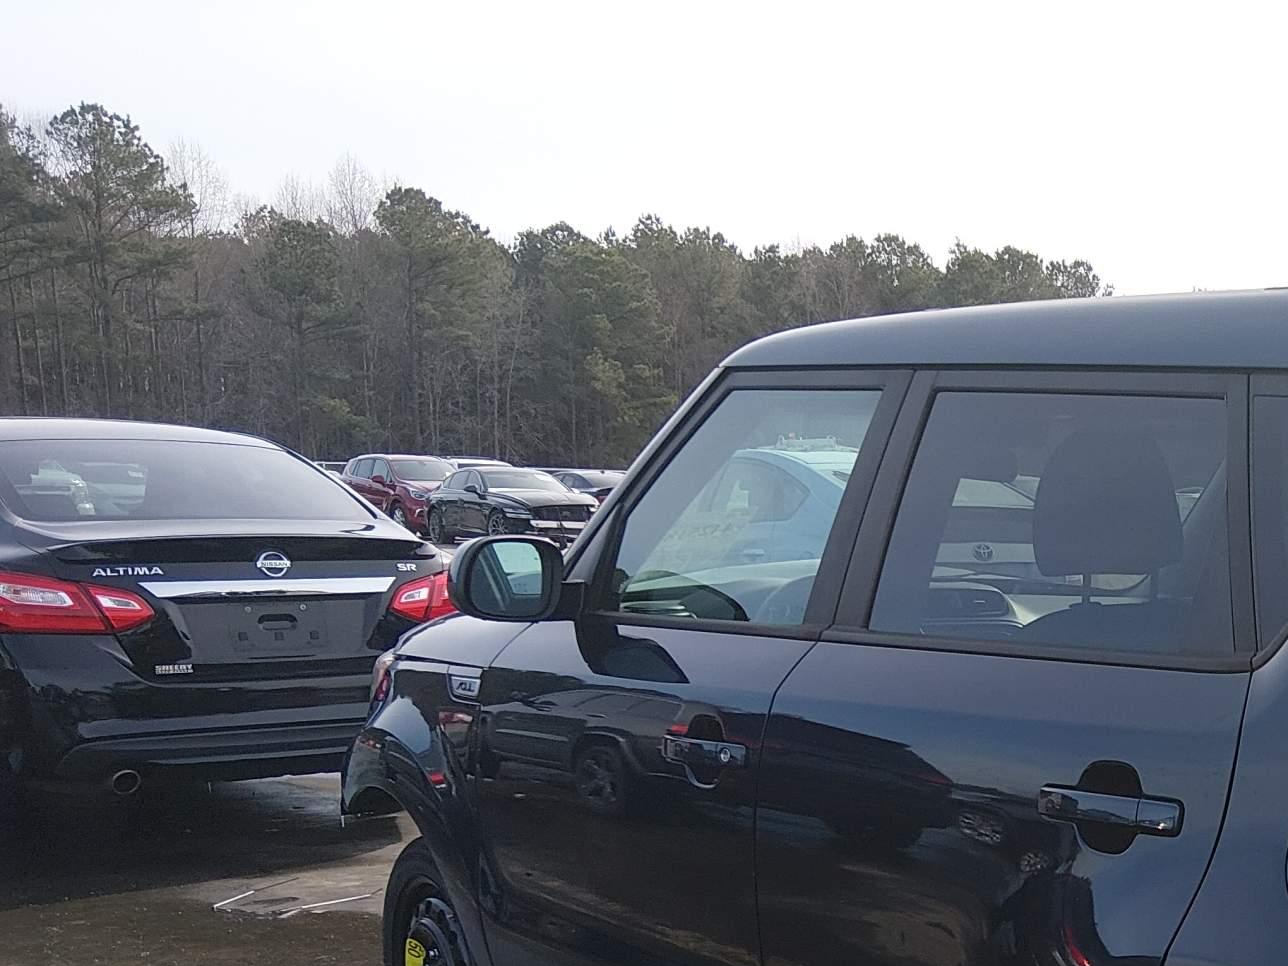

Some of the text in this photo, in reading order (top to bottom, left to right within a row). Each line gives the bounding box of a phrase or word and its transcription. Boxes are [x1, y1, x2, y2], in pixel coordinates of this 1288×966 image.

[260, 560, 288, 568] NISSAN
[396, 563, 417, 572] SR
[92, 566, 164, 577] ALTIMA
